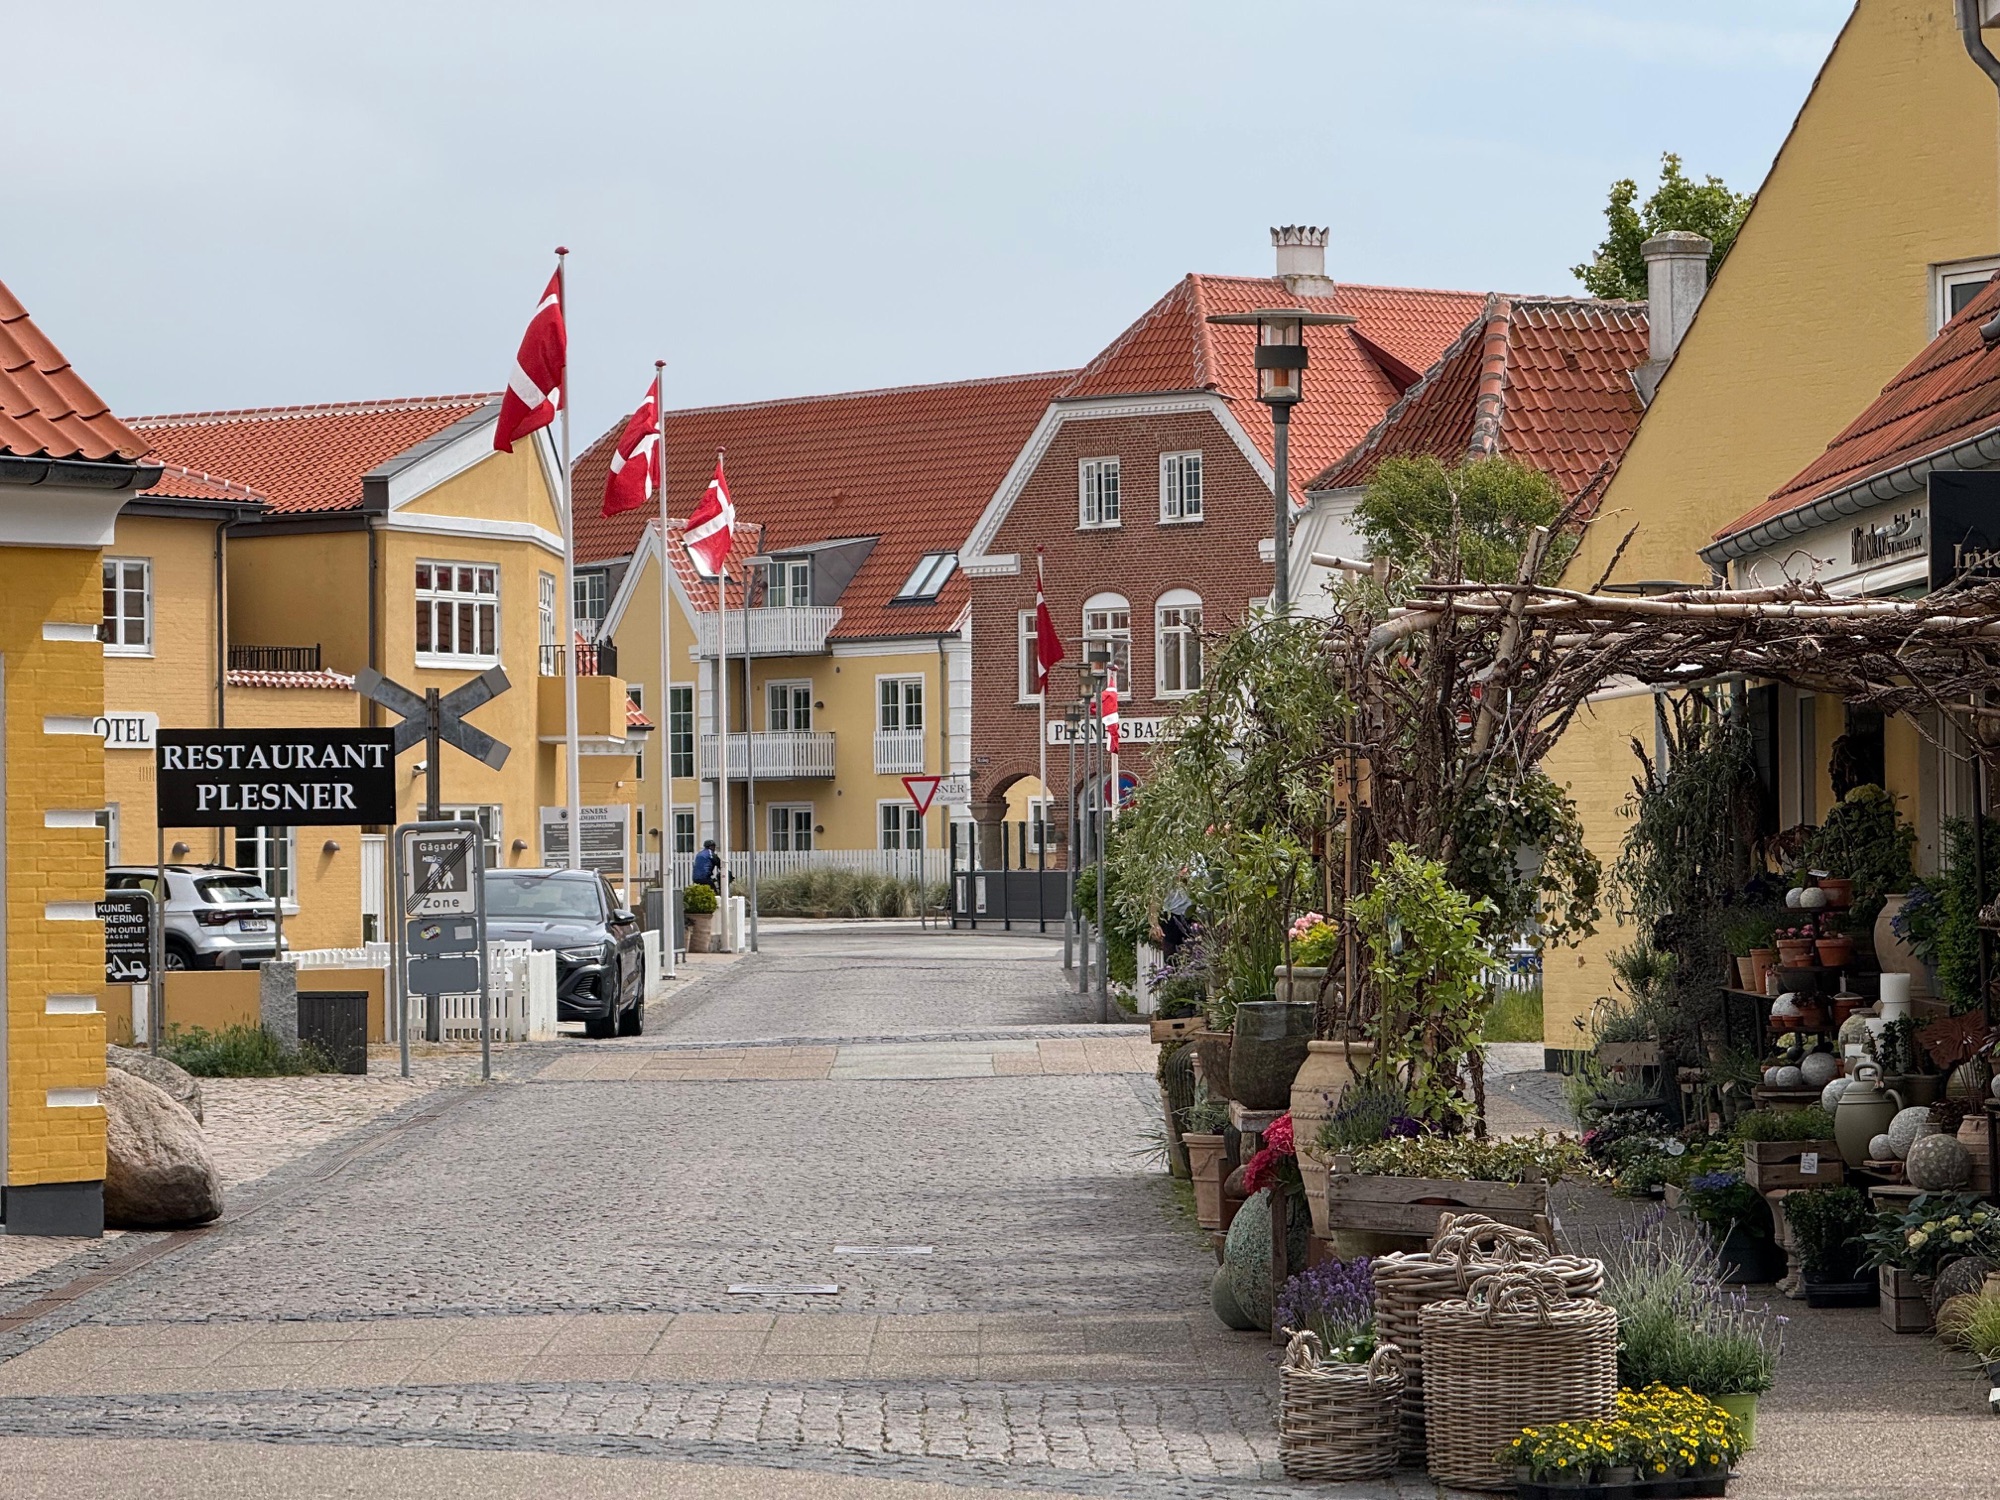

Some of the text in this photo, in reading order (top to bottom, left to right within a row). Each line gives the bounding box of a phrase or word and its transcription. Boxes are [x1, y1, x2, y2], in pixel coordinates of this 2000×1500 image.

[162, 744, 389, 770] RESTAURANT
[196, 783, 357, 811] PLESNER
[579, 807, 608, 815] ESNERS
[419, 842, 459, 853] Gågade
[97, 904, 132, 912] KUNDE
[423, 898, 460, 908] Zone
